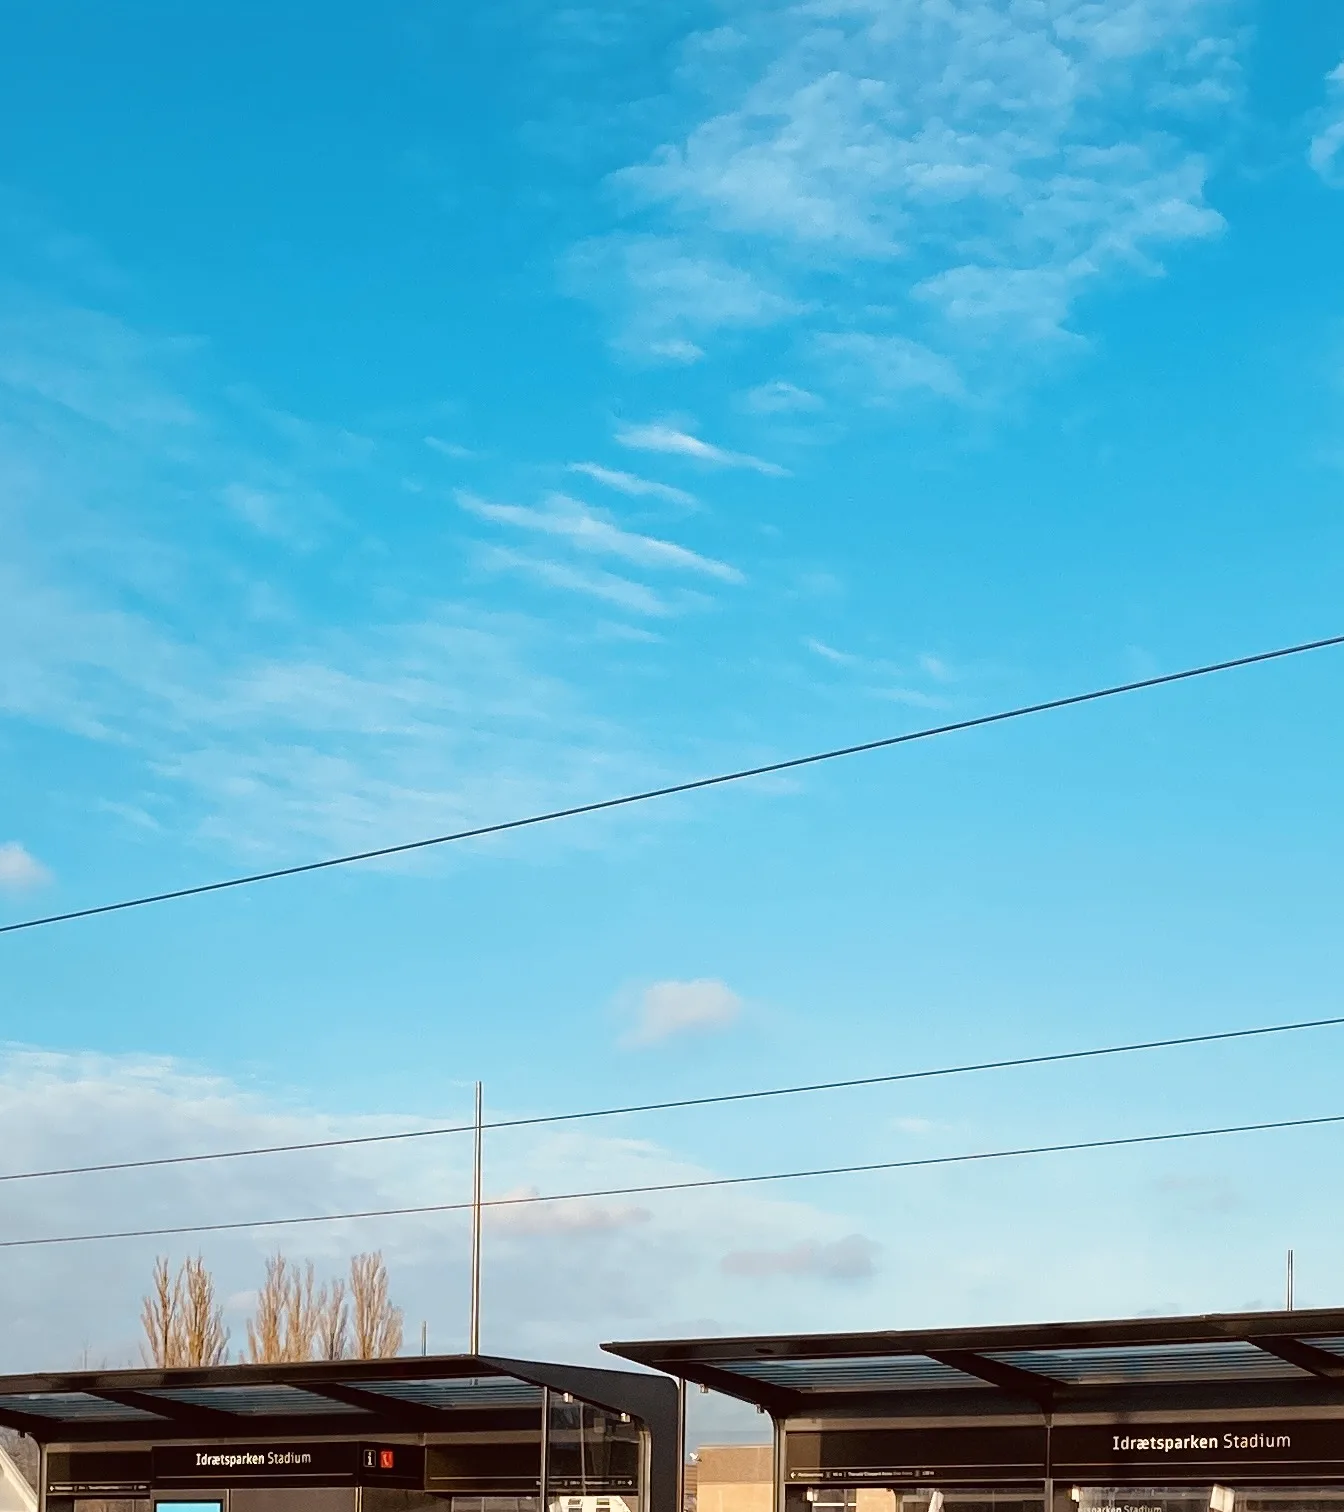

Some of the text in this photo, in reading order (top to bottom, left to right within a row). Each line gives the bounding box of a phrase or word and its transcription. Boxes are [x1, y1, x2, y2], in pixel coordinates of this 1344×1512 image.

[1112, 1433, 1291, 1452] Idrætsparken Stadium
[195, 1451, 312, 1467] Idrætsparken Stadium
